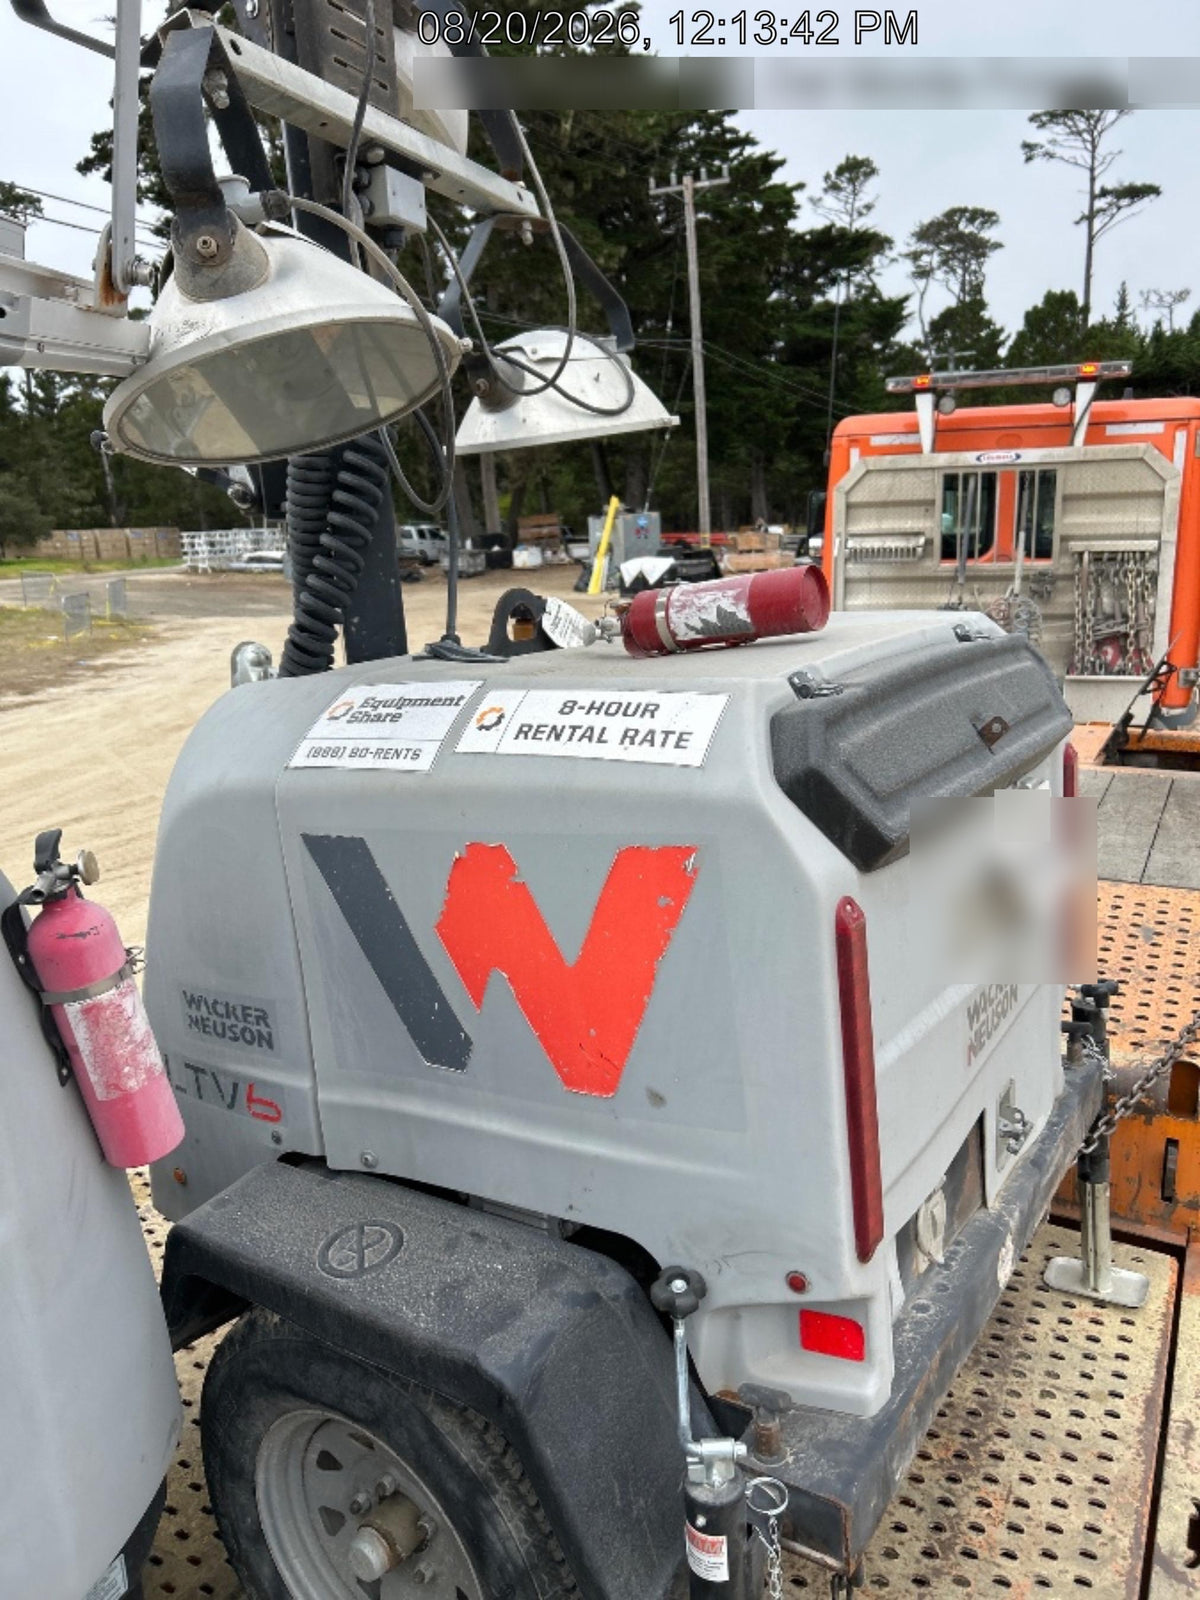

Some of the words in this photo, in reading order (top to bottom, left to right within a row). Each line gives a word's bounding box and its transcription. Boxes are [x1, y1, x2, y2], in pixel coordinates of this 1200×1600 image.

[358, 694, 466, 711] Equipment
[558, 699, 661, 720] 8-HOUR
[346, 710, 403, 725] Share
[513, 722, 610, 745] RENTAL
[618, 726, 694, 750] RATE
[188, 1014, 275, 1052] NEUSON
